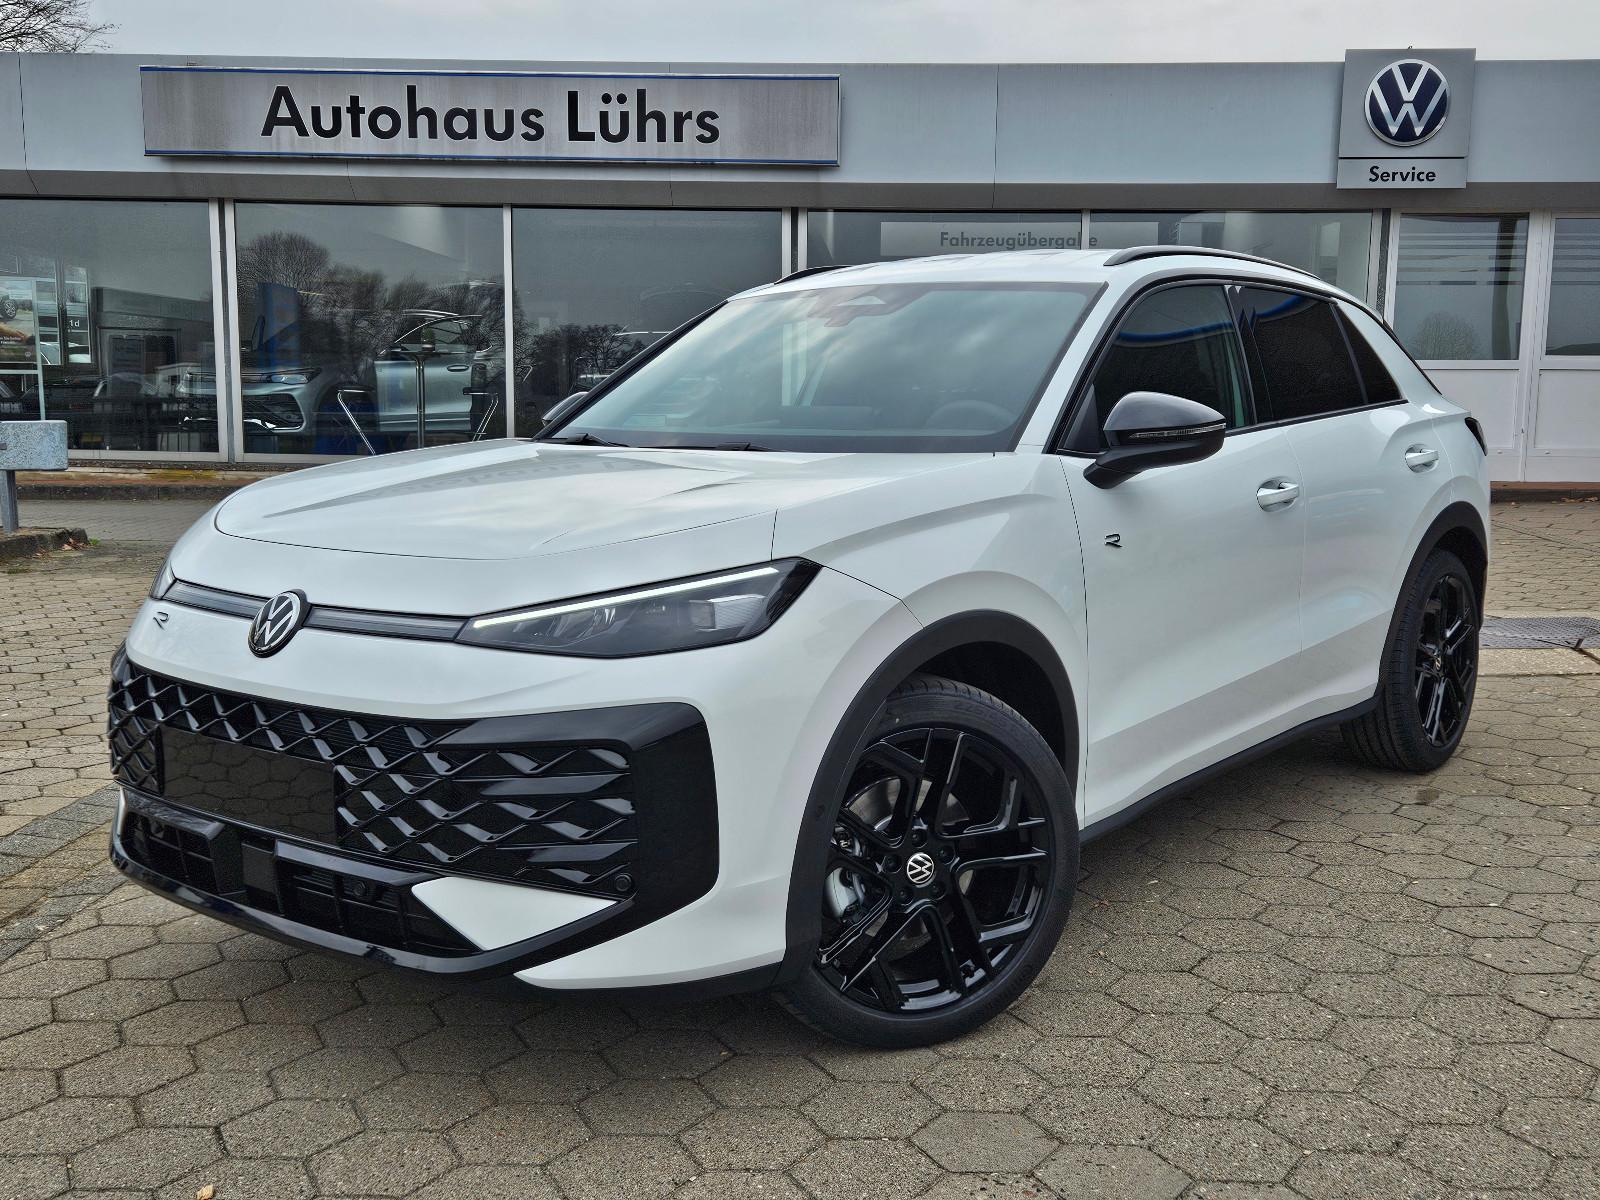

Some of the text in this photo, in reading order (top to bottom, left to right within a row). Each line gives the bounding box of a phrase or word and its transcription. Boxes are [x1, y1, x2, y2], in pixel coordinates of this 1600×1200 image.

[261, 85, 720, 144] Autohaus Lührs
[1366, 60, 1449, 146] VW
[1368, 165, 1436, 182] Service
